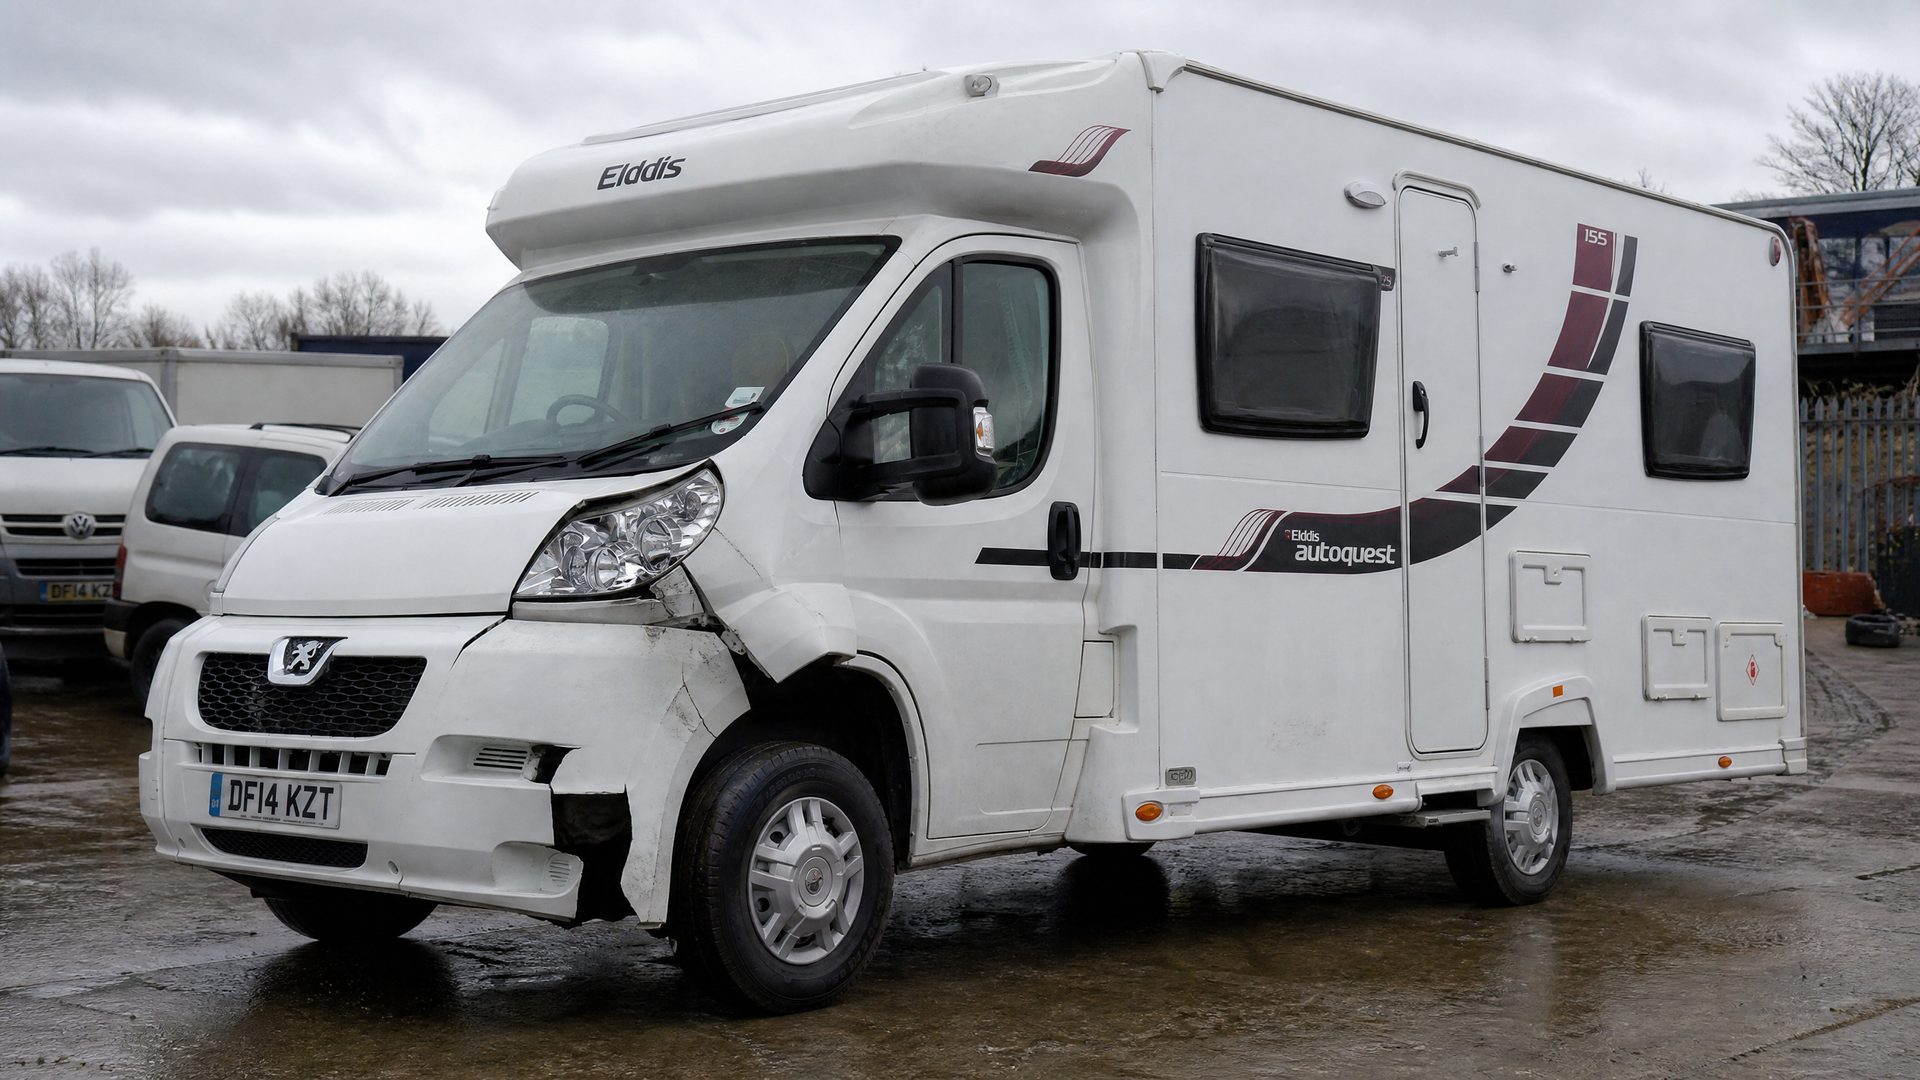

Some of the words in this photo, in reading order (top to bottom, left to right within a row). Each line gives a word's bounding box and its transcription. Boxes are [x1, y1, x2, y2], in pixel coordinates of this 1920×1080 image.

[597, 155, 686, 190] Elddis
[1584, 228, 1607, 246] 155
[1291, 529, 1320, 542] Elddis
[1295, 542, 1396, 567] autoquest
[51, 583, 87, 599] DF14
[93, 583, 113, 599] KZ
[228, 779, 278, 815] DF14
[285, 784, 334, 820] KZT
